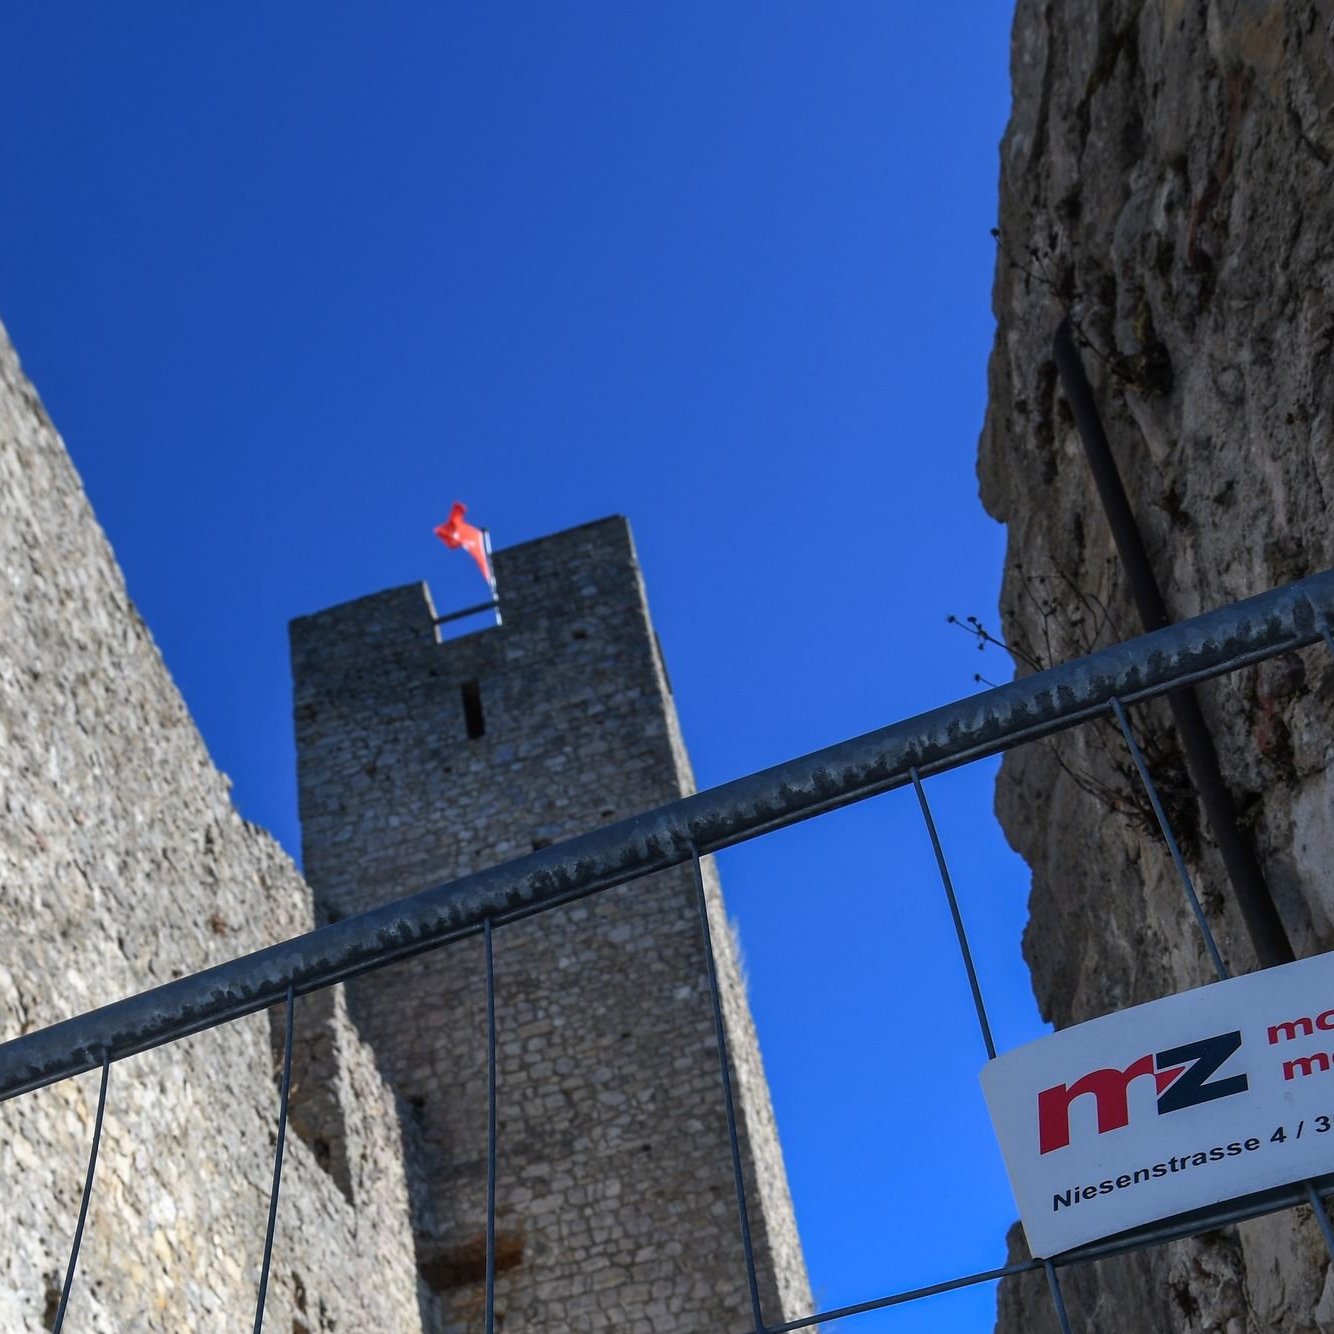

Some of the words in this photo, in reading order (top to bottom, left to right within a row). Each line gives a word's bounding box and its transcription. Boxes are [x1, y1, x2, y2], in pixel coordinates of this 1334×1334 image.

[1037, 1029, 1250, 1156] mz
[1052, 1136, 1262, 1213] Niesenstrasse
[1269, 1126, 1288, 1144] 4
[1295, 1120, 1305, 1140] /
